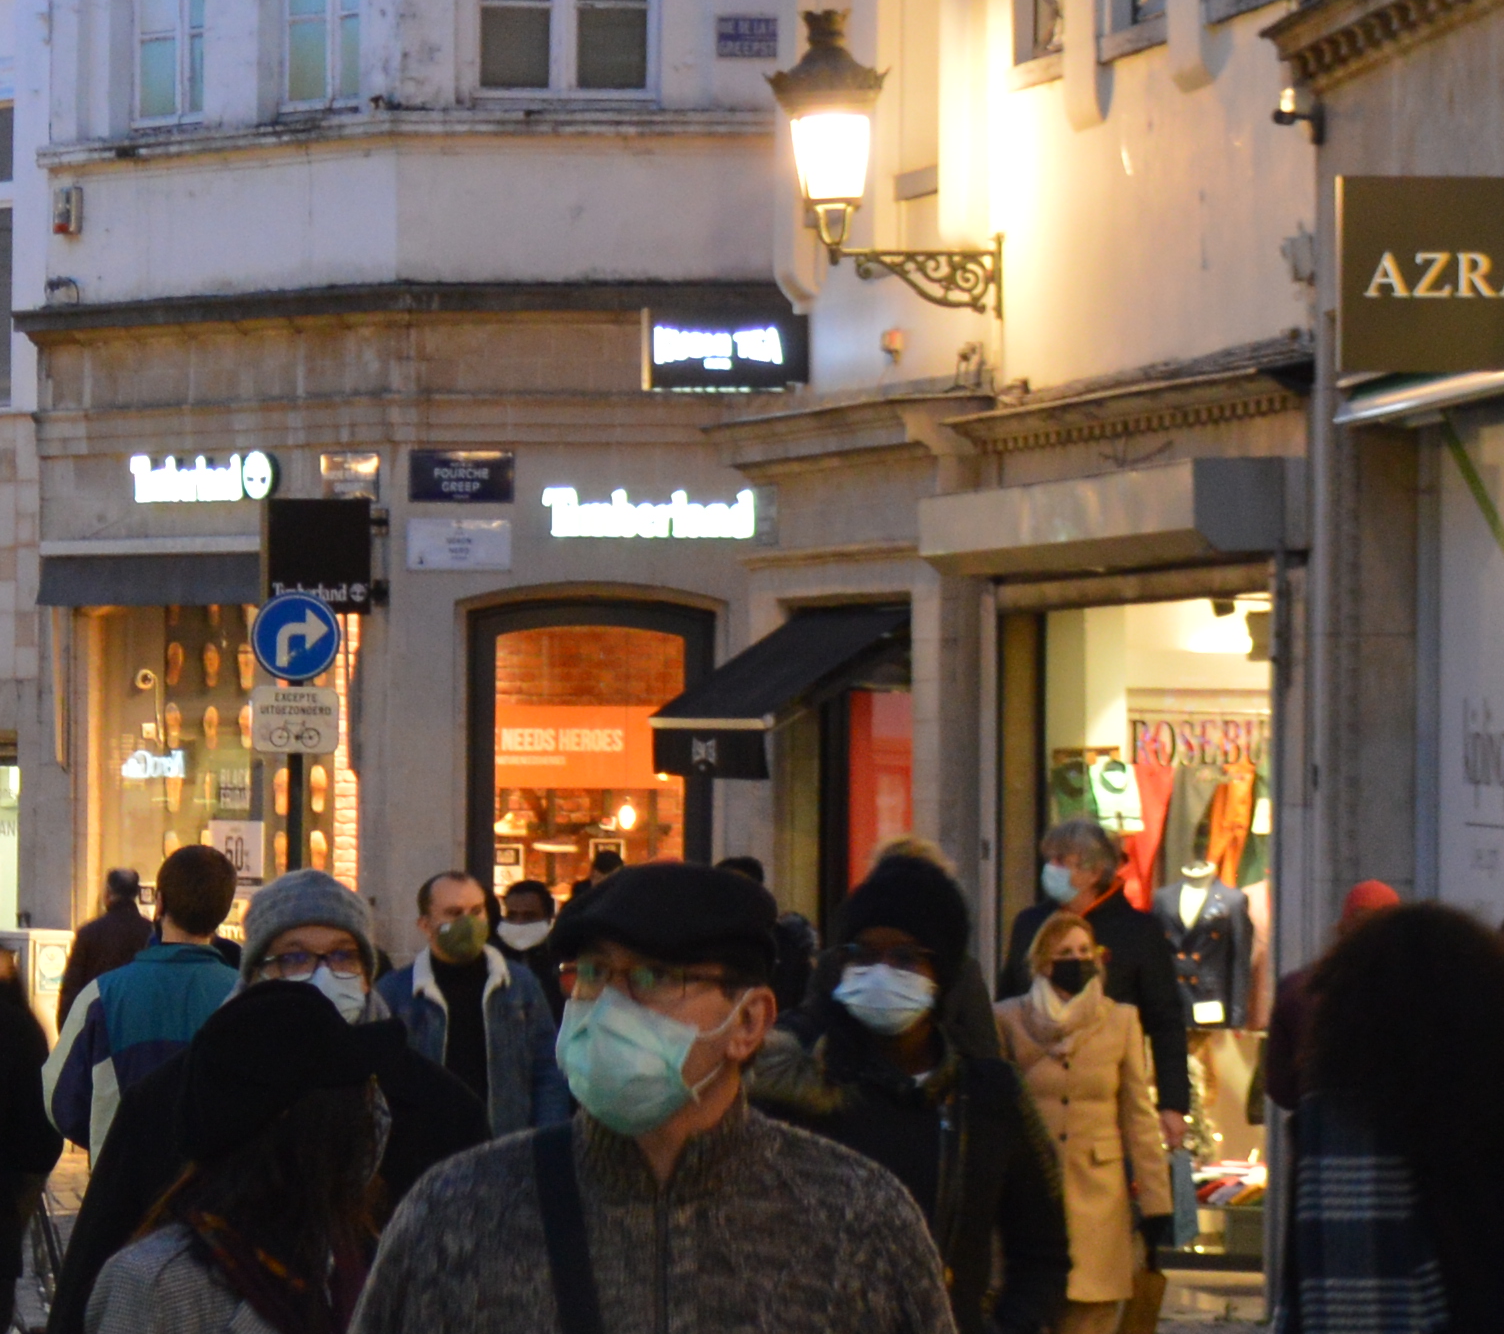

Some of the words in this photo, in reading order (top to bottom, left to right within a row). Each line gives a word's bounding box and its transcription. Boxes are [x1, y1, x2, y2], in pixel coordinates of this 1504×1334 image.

[433, 468, 490, 480] FOURCHE
[441, 481, 481, 493] GREEP
[501, 728, 556, 752] NEEDS
[557, 728, 624, 752] HEROES
